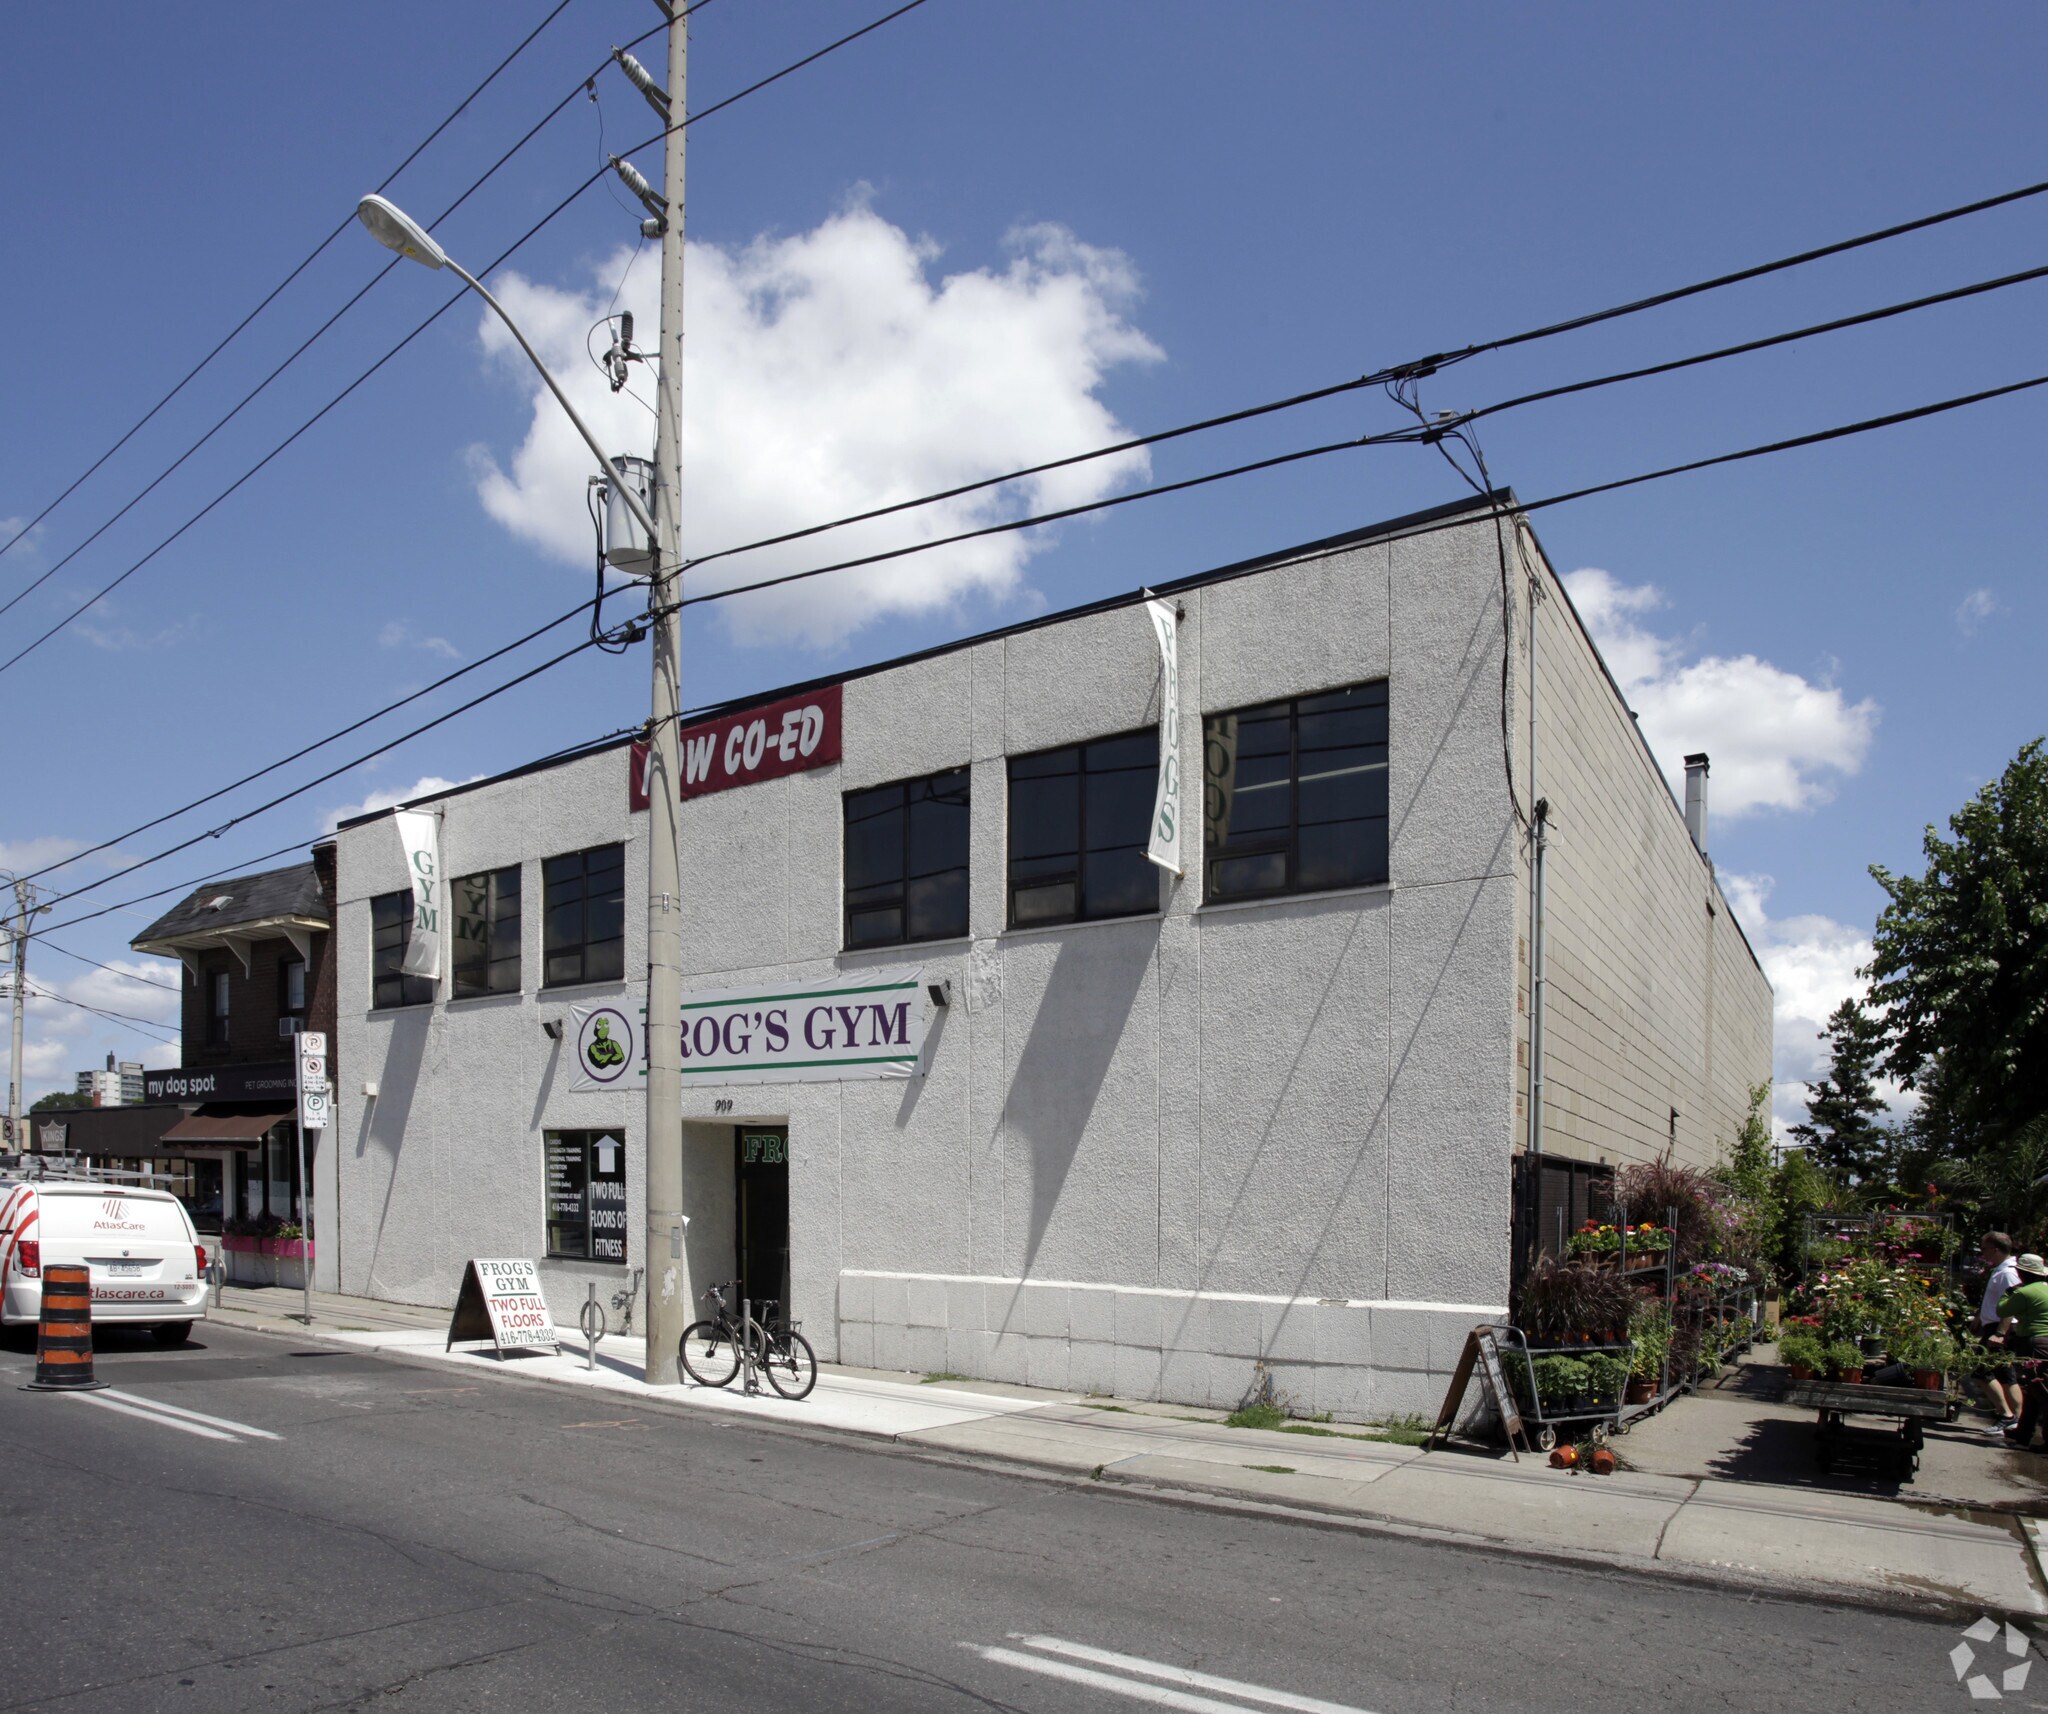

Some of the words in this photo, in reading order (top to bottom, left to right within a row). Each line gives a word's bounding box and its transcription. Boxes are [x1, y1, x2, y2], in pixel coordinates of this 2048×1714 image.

[724, 704, 824, 776] CO-ED
[413, 850, 438, 933] GYM
[803, 1002, 911, 1050] GYM
[148, 1080, 164, 1098] my
[166, 1075, 188, 1096] dog
[189, 1074, 215, 1096] spot
[245, 1081, 255, 1090] PET
[256, 1079, 287, 1089] GROOMING
[715, 1100, 733, 1112] 909
[42, 1130, 65, 1142] KINGS
[592, 1182, 608, 1199] TWO
[608, 1182, 625, 1200] FULL
[94, 1220, 146, 1231] AtlasCare
[591, 1210, 616, 1228] FLOORS
[595, 1239, 623, 1257] FITNESS
[481, 1262, 534, 1276] FROG'S
[495, 1277, 530, 1291] GYM
[89, 1287, 165, 1299] tlascare.ca
[489, 1298, 518, 1312] TWO
[519, 1298, 546, 1311] FULL
[501, 1313, 545, 1328] FLOORS
[500, 1328, 556, 1345] 416-778-4332
